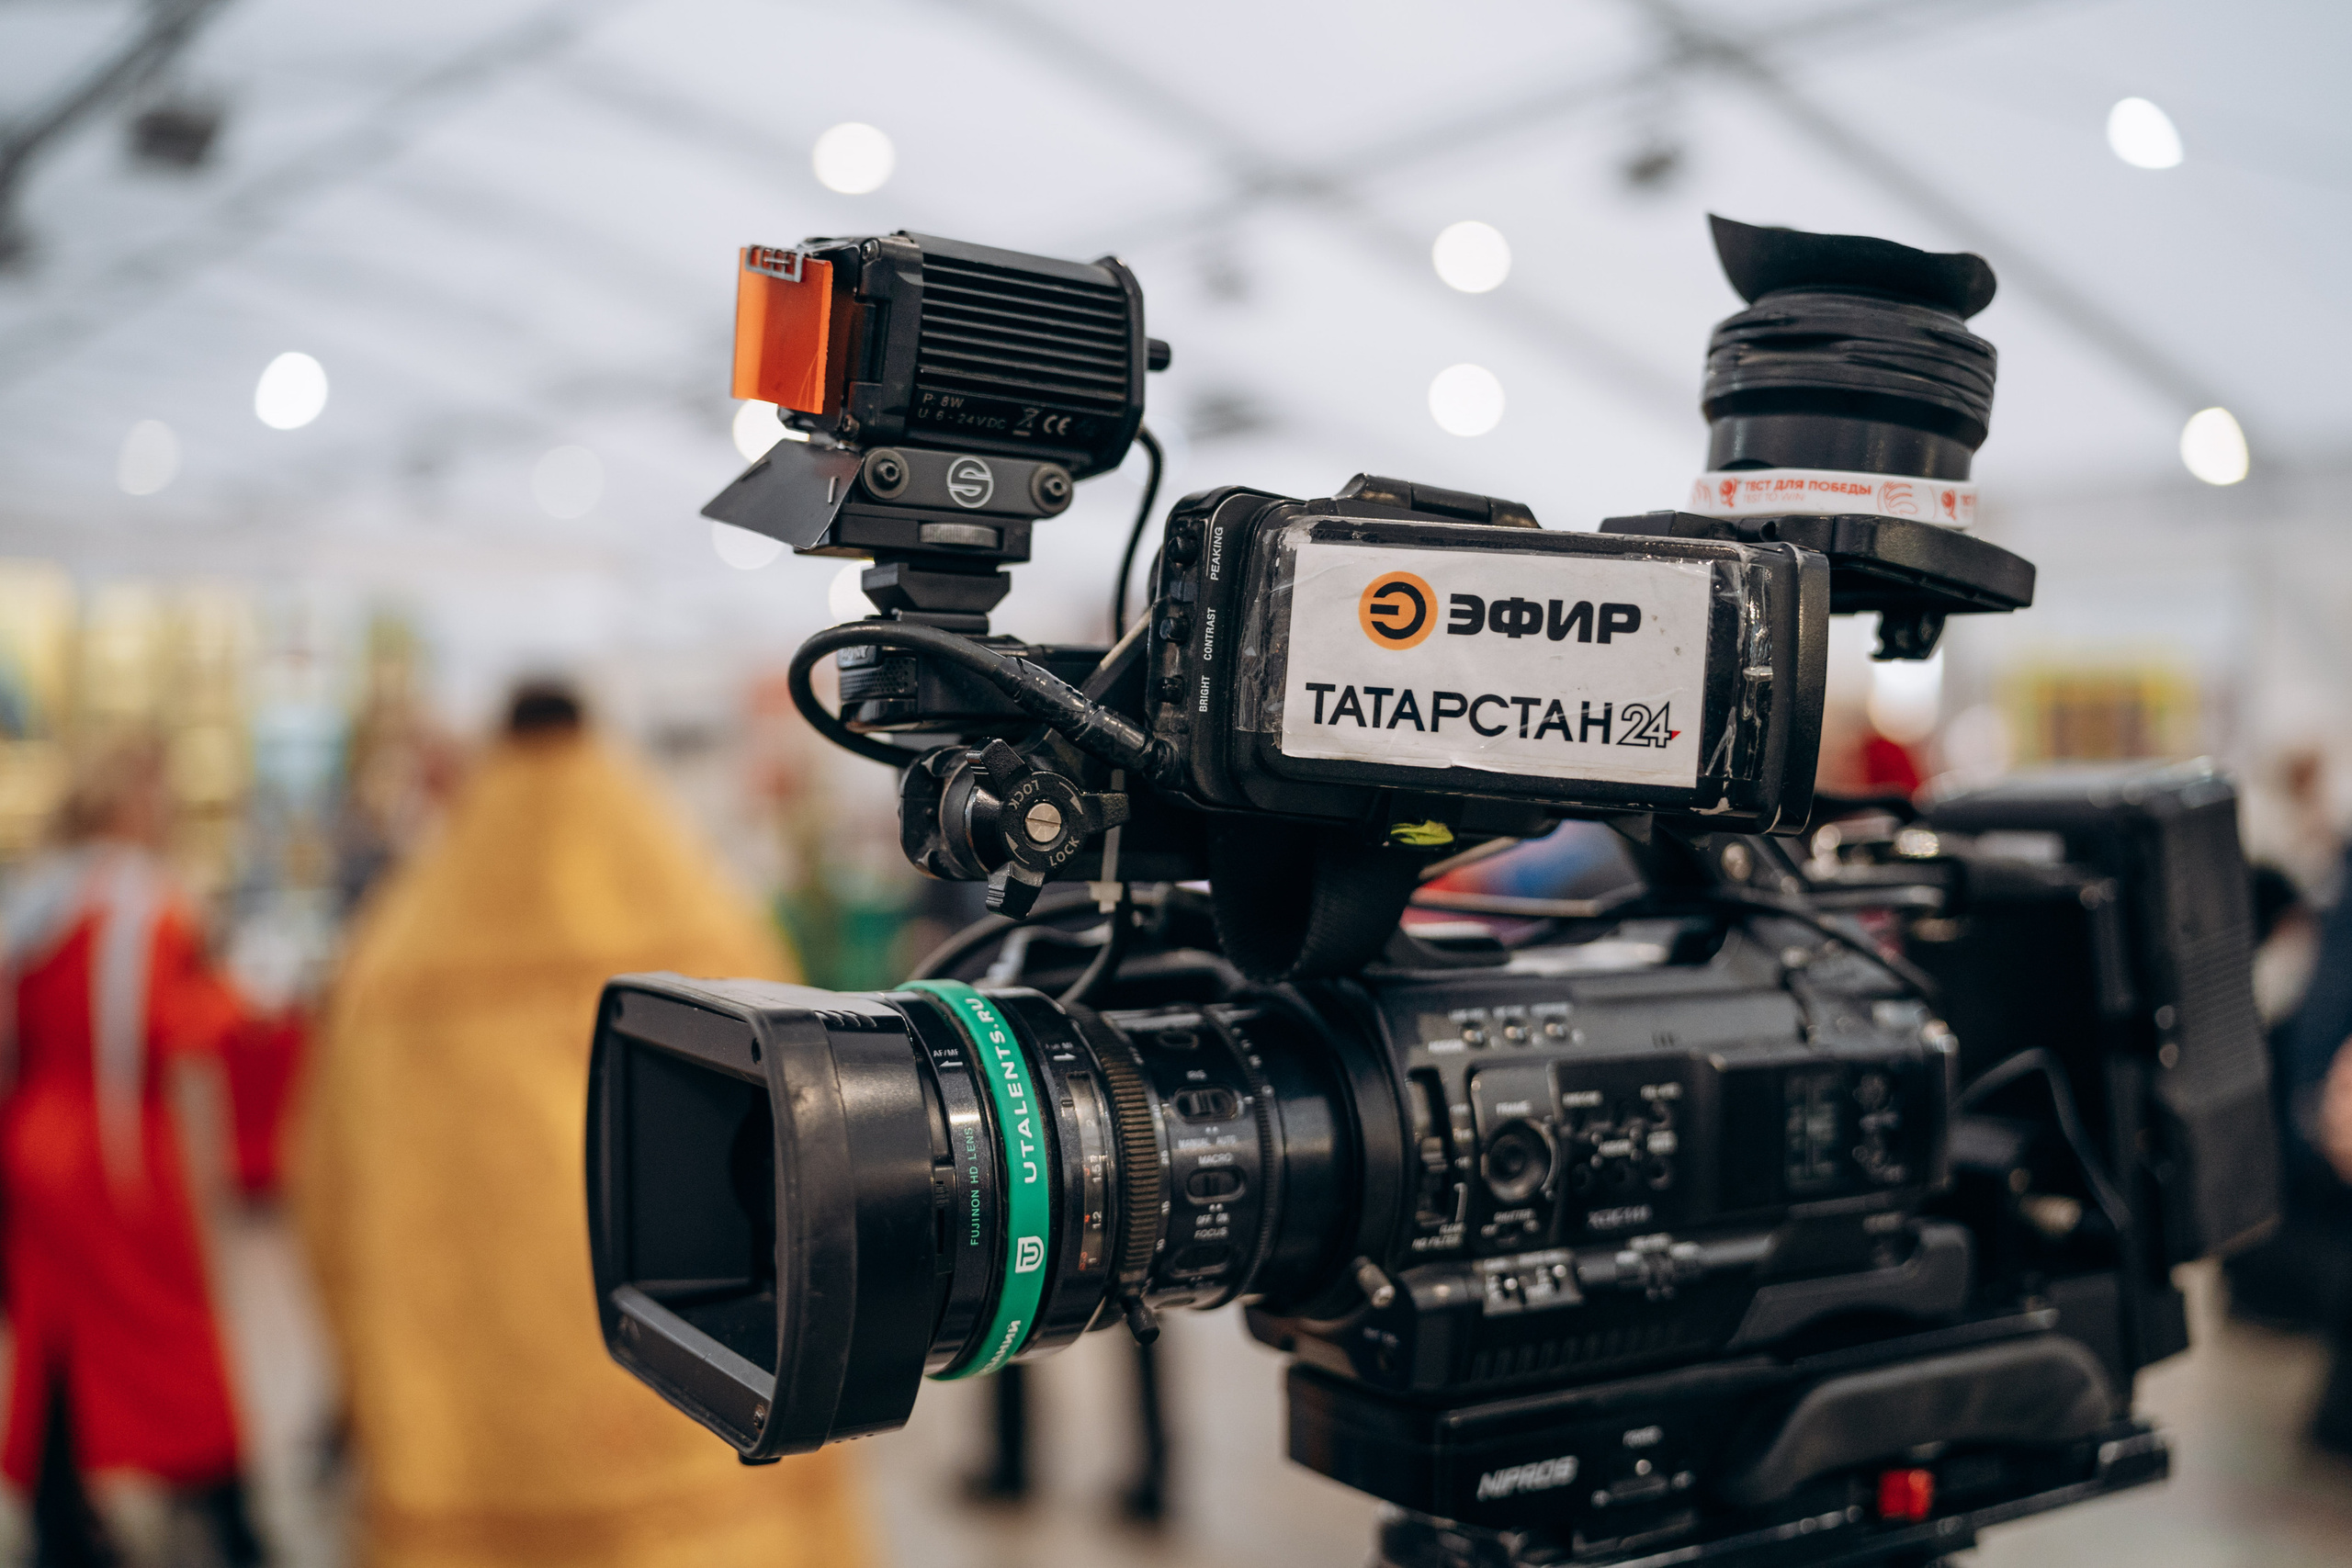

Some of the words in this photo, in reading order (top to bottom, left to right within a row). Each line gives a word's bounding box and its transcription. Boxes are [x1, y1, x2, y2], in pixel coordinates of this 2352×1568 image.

[941, 396, 965, 409] 8W
[1745, 479, 1771, 491] ТЕСТ
[1773, 479, 1804, 491] ДЛЯ
[1808, 480, 1872, 495] ПОБЕДЫ
[1210, 526, 1224, 581] PEAKING
[1203, 607, 1216, 661] CONTRAST
[1446, 592, 1643, 645] ЭФИР
[1198, 675, 1211, 713] BRIGHT
[1008, 779, 1041, 811] LOCK
[1048, 835, 1080, 867] LOCK
[965, 998, 1037, 1184] UTALENTS.RU
[965, 1127, 977, 1161] LENS
[1198, 1152, 1234, 1167] MACRO
[970, 1166, 978, 1184] HD
[970, 1189, 980, 1246] FUJINON
[1091, 1211, 1102, 1229] 1.2
[1194, 1226, 1229, 1239] FOCUS
